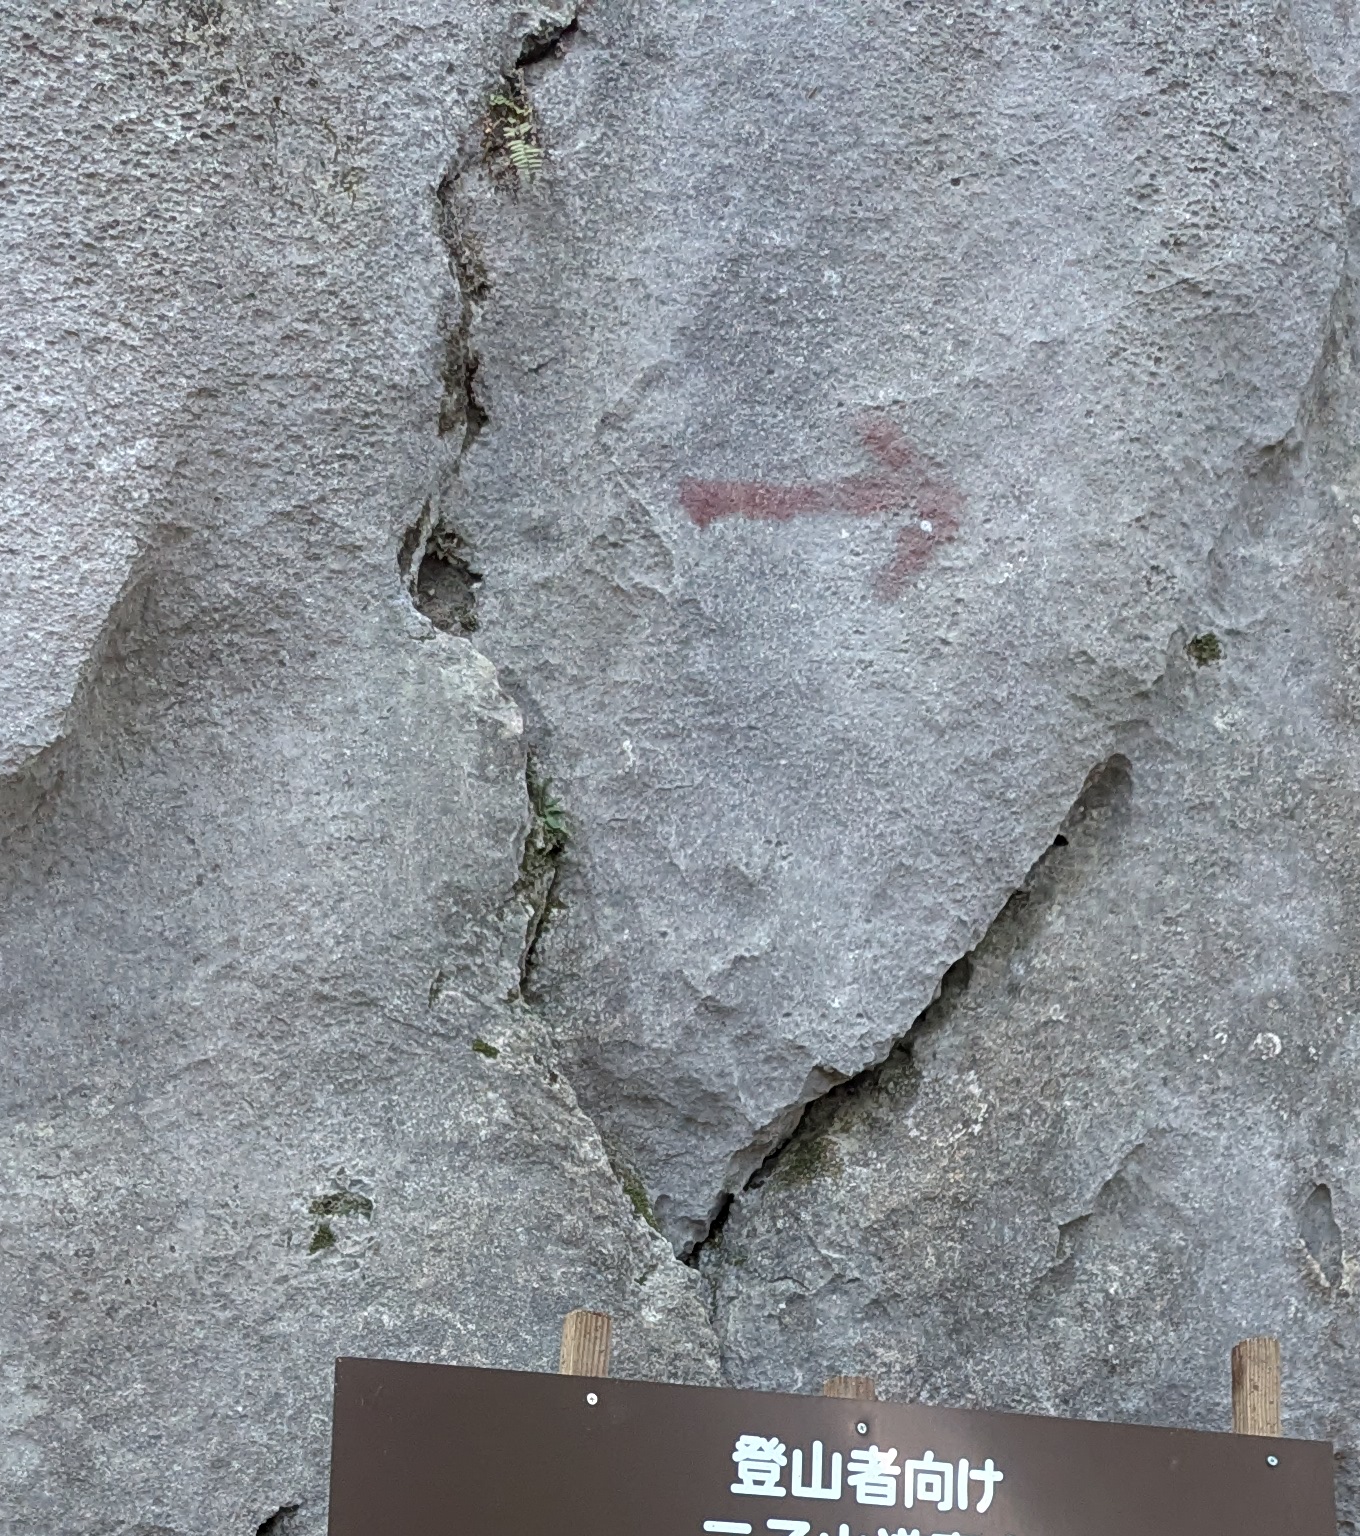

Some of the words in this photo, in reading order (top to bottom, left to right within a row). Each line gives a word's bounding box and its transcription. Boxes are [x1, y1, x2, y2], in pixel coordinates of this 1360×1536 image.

[730, 1434, 1004, 1514] 登山者向け
